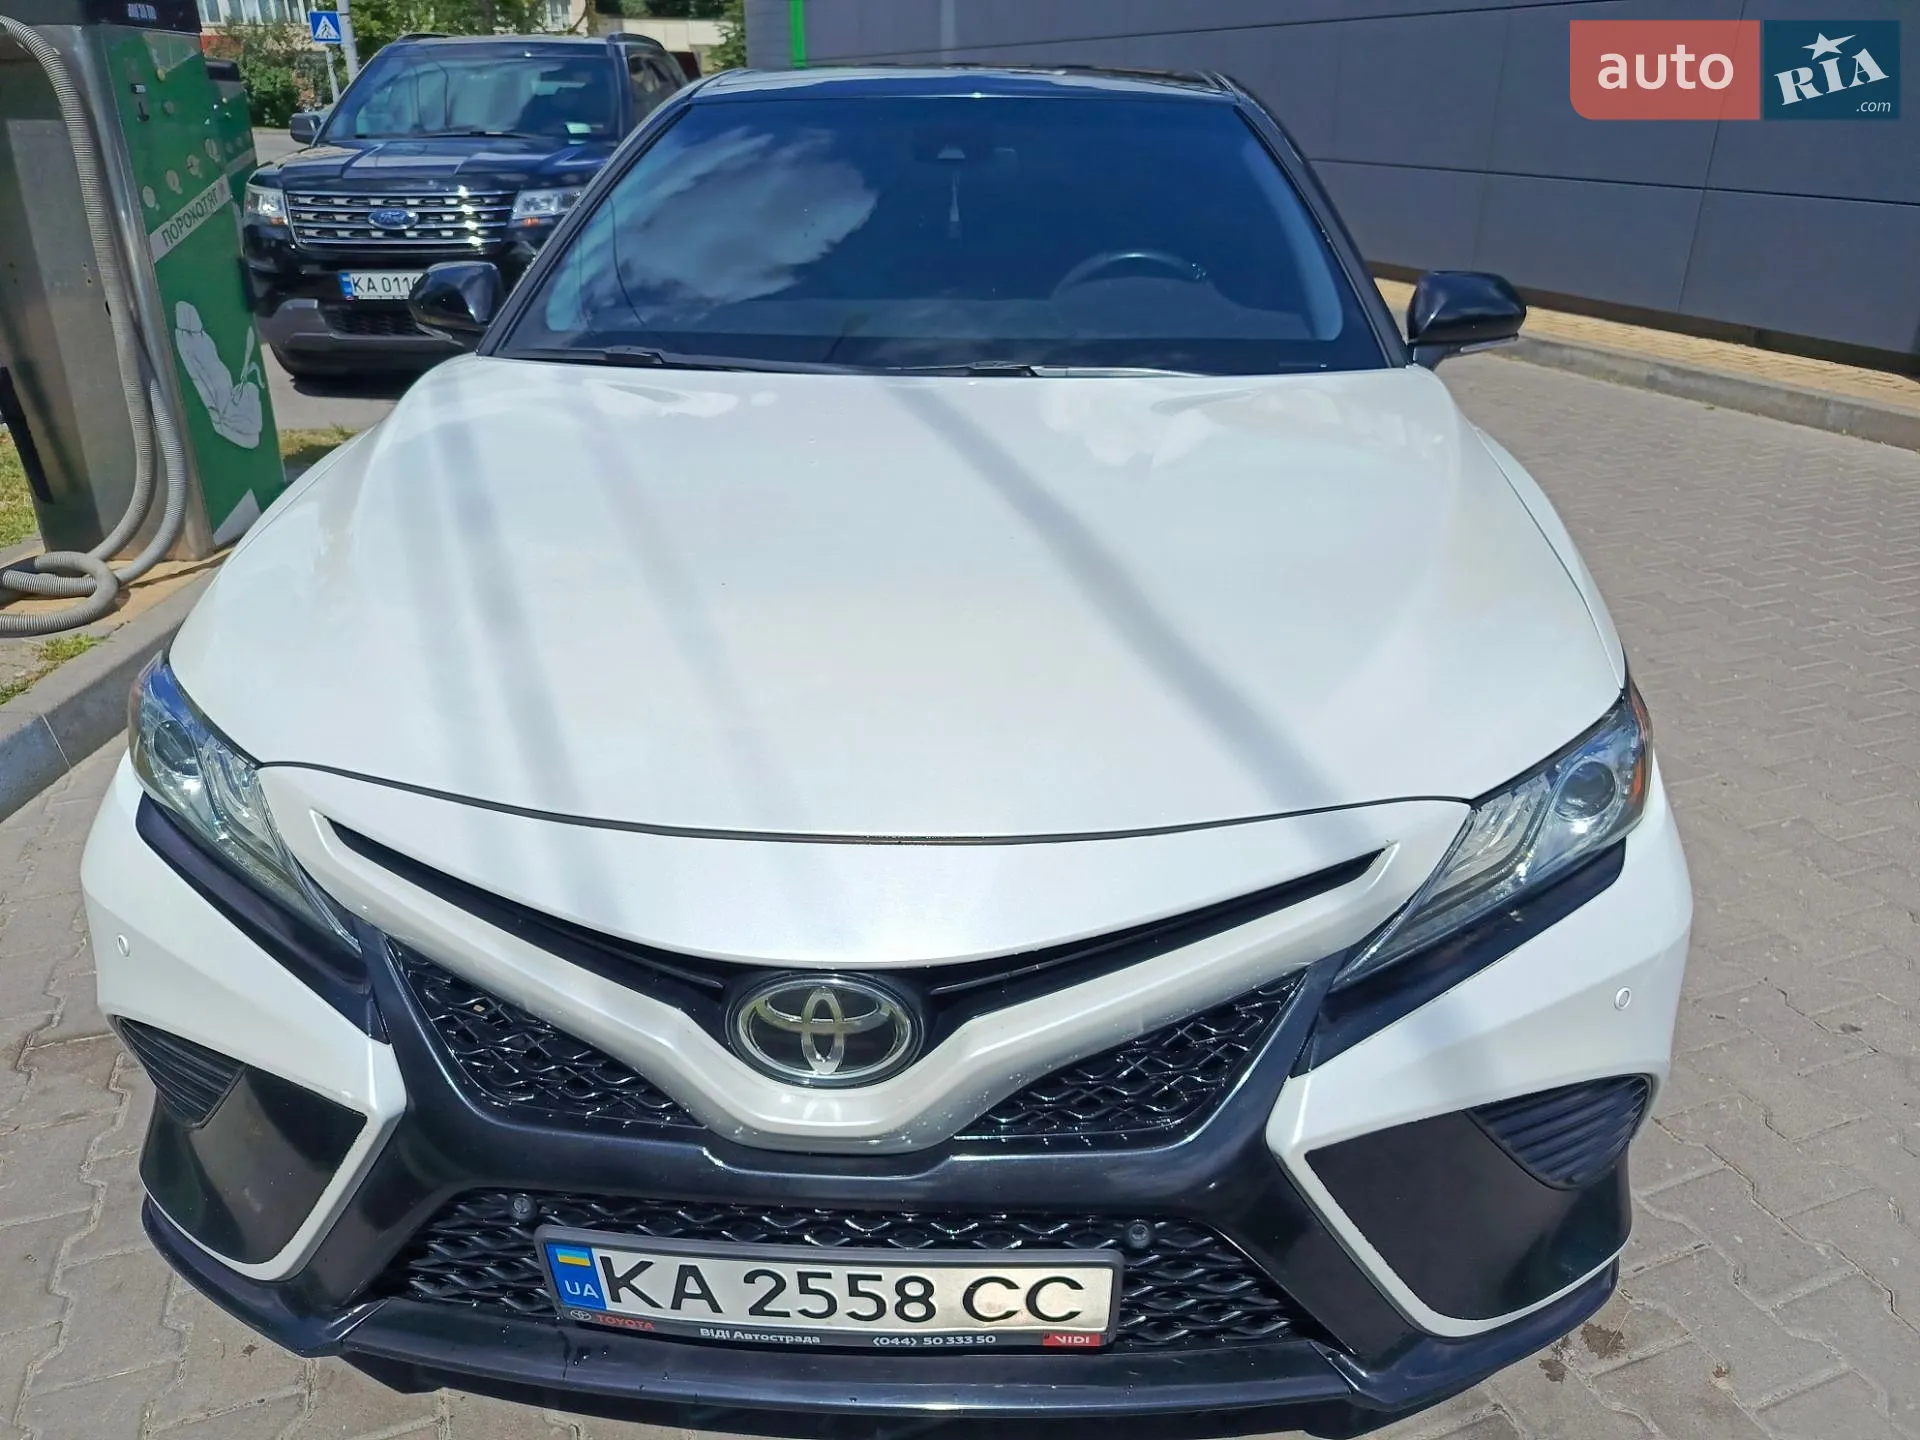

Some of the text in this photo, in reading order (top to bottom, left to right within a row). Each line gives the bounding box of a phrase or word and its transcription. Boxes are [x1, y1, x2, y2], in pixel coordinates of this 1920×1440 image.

[161, 187, 218, 247] ПОРОХОТЯГ
[352, 277, 377, 292] KA
[564, 1279, 599, 1299] UA
[600, 1256, 1085, 1323] KA 2558 CC
[595, 1314, 654, 1330] TOYOTA
[700, 1328, 821, 1344] ВІДІ Автострада
[873, 1335, 996, 1346] (044) 50 333 50
[1054, 1335, 1090, 1344] VIDI
